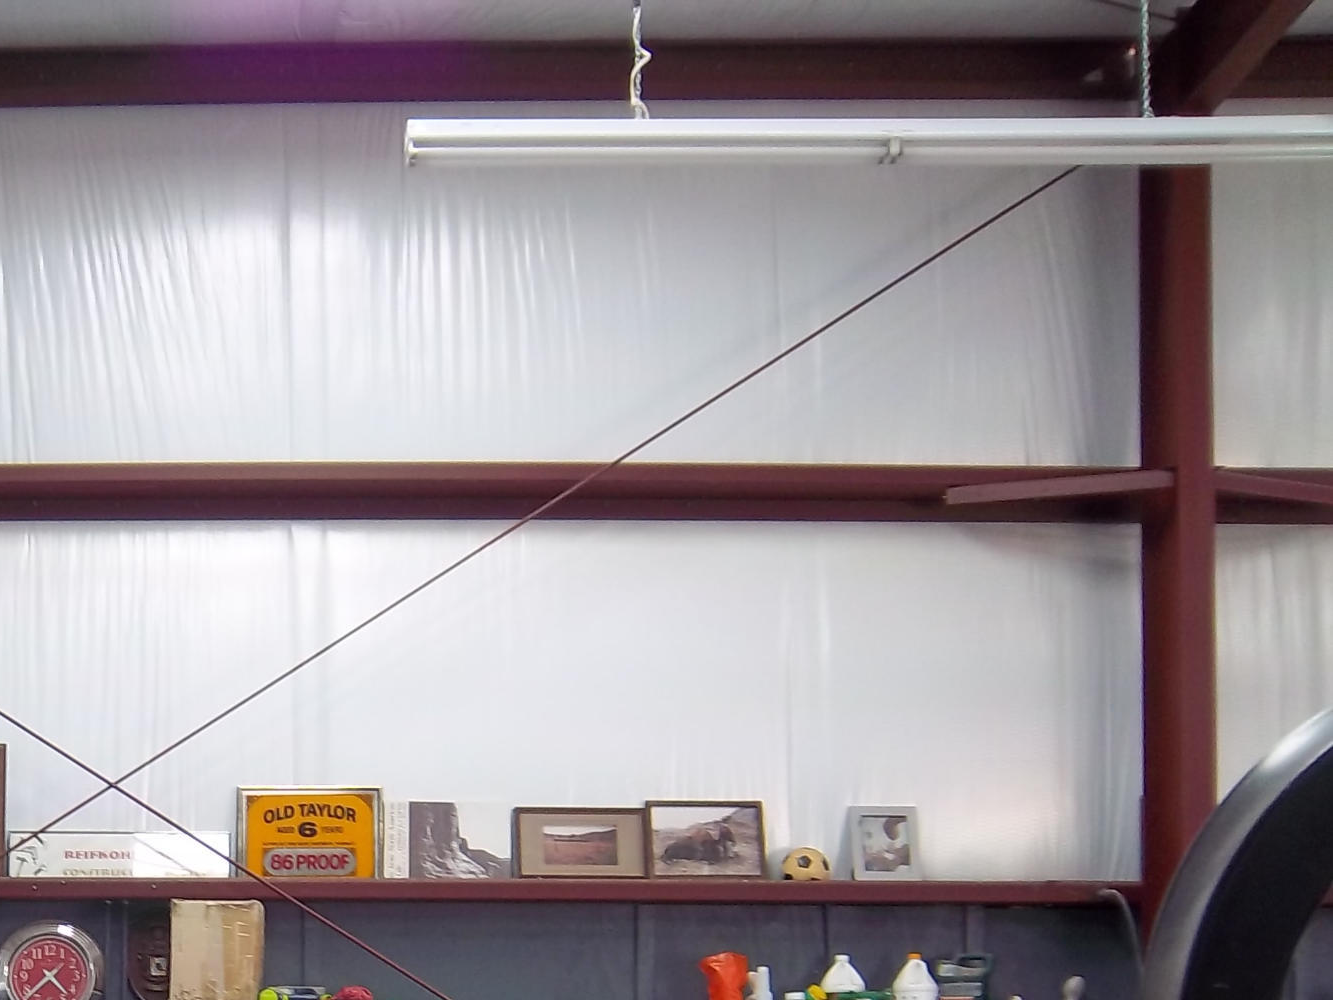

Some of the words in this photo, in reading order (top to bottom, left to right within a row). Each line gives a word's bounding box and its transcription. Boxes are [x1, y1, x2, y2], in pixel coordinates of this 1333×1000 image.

[263, 805, 295, 824] OLD
[298, 803, 357, 823] TAYLOR
[298, 821, 317, 838] 6
[270, 853, 294, 871] 86
[296, 853, 351, 871] PROOF
[31, 947, 43, 959] 11
[44, 944, 57, 956] 12
[21, 958, 35, 970] 10
[19, 970, 29, 982] 9
